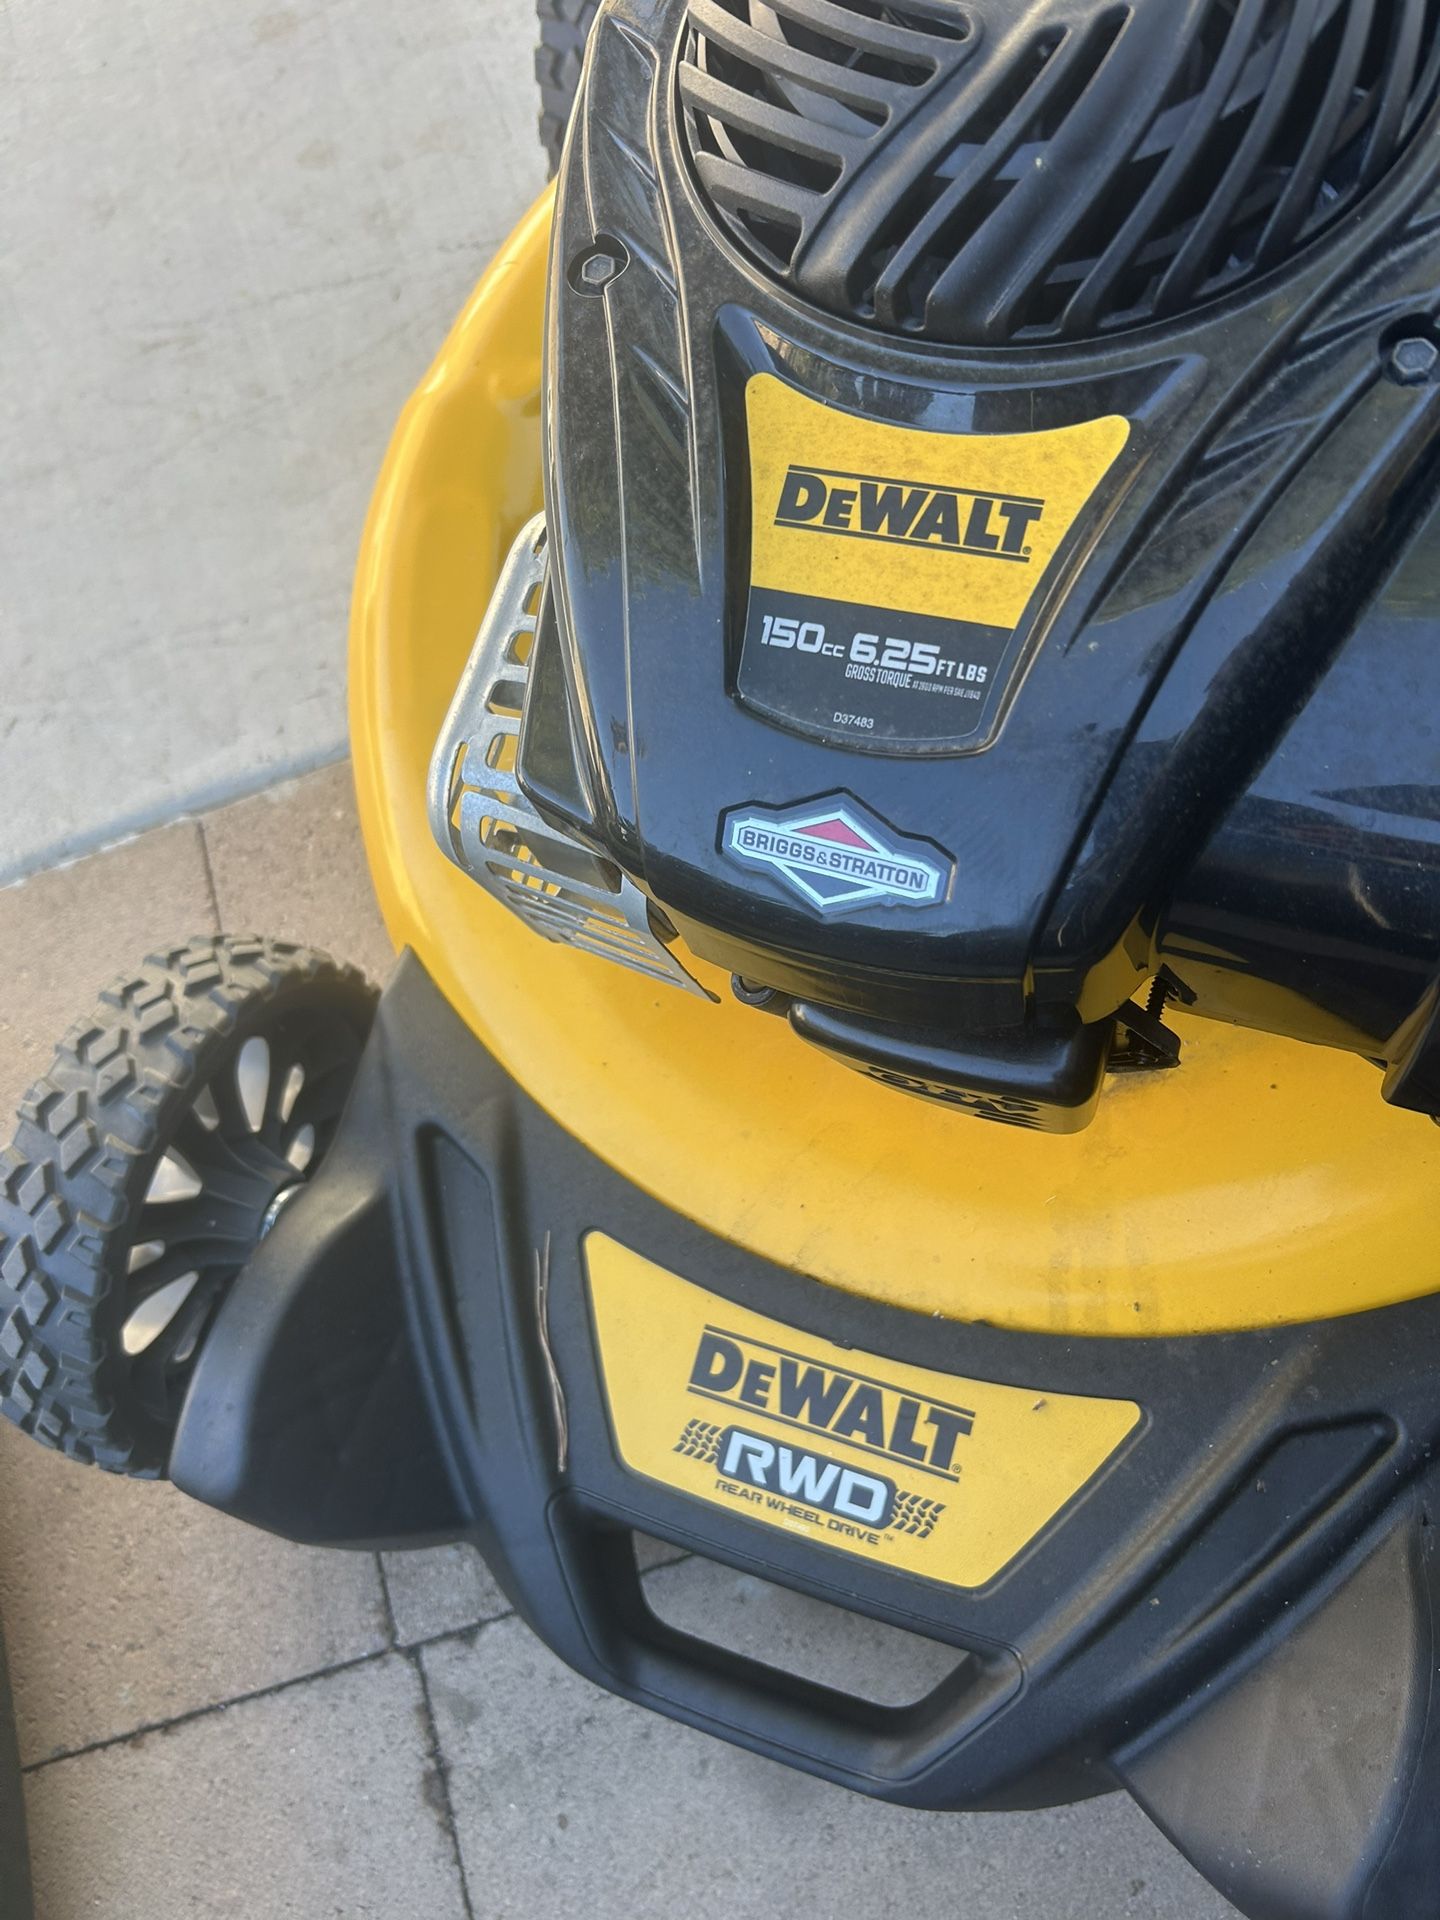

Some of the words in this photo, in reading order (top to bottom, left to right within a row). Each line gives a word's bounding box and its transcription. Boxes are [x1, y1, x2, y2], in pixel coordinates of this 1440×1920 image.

[760, 615, 845, 658] 150cc
[956, 662, 988, 683] LBS
[833, 712, 874, 729] D37483
[722, 1429, 889, 1523] RWD
[714, 1479, 763, 1504] REAR
[766, 1496, 825, 1526] WHEEL
[827, 1517, 881, 1545] DRIVE
